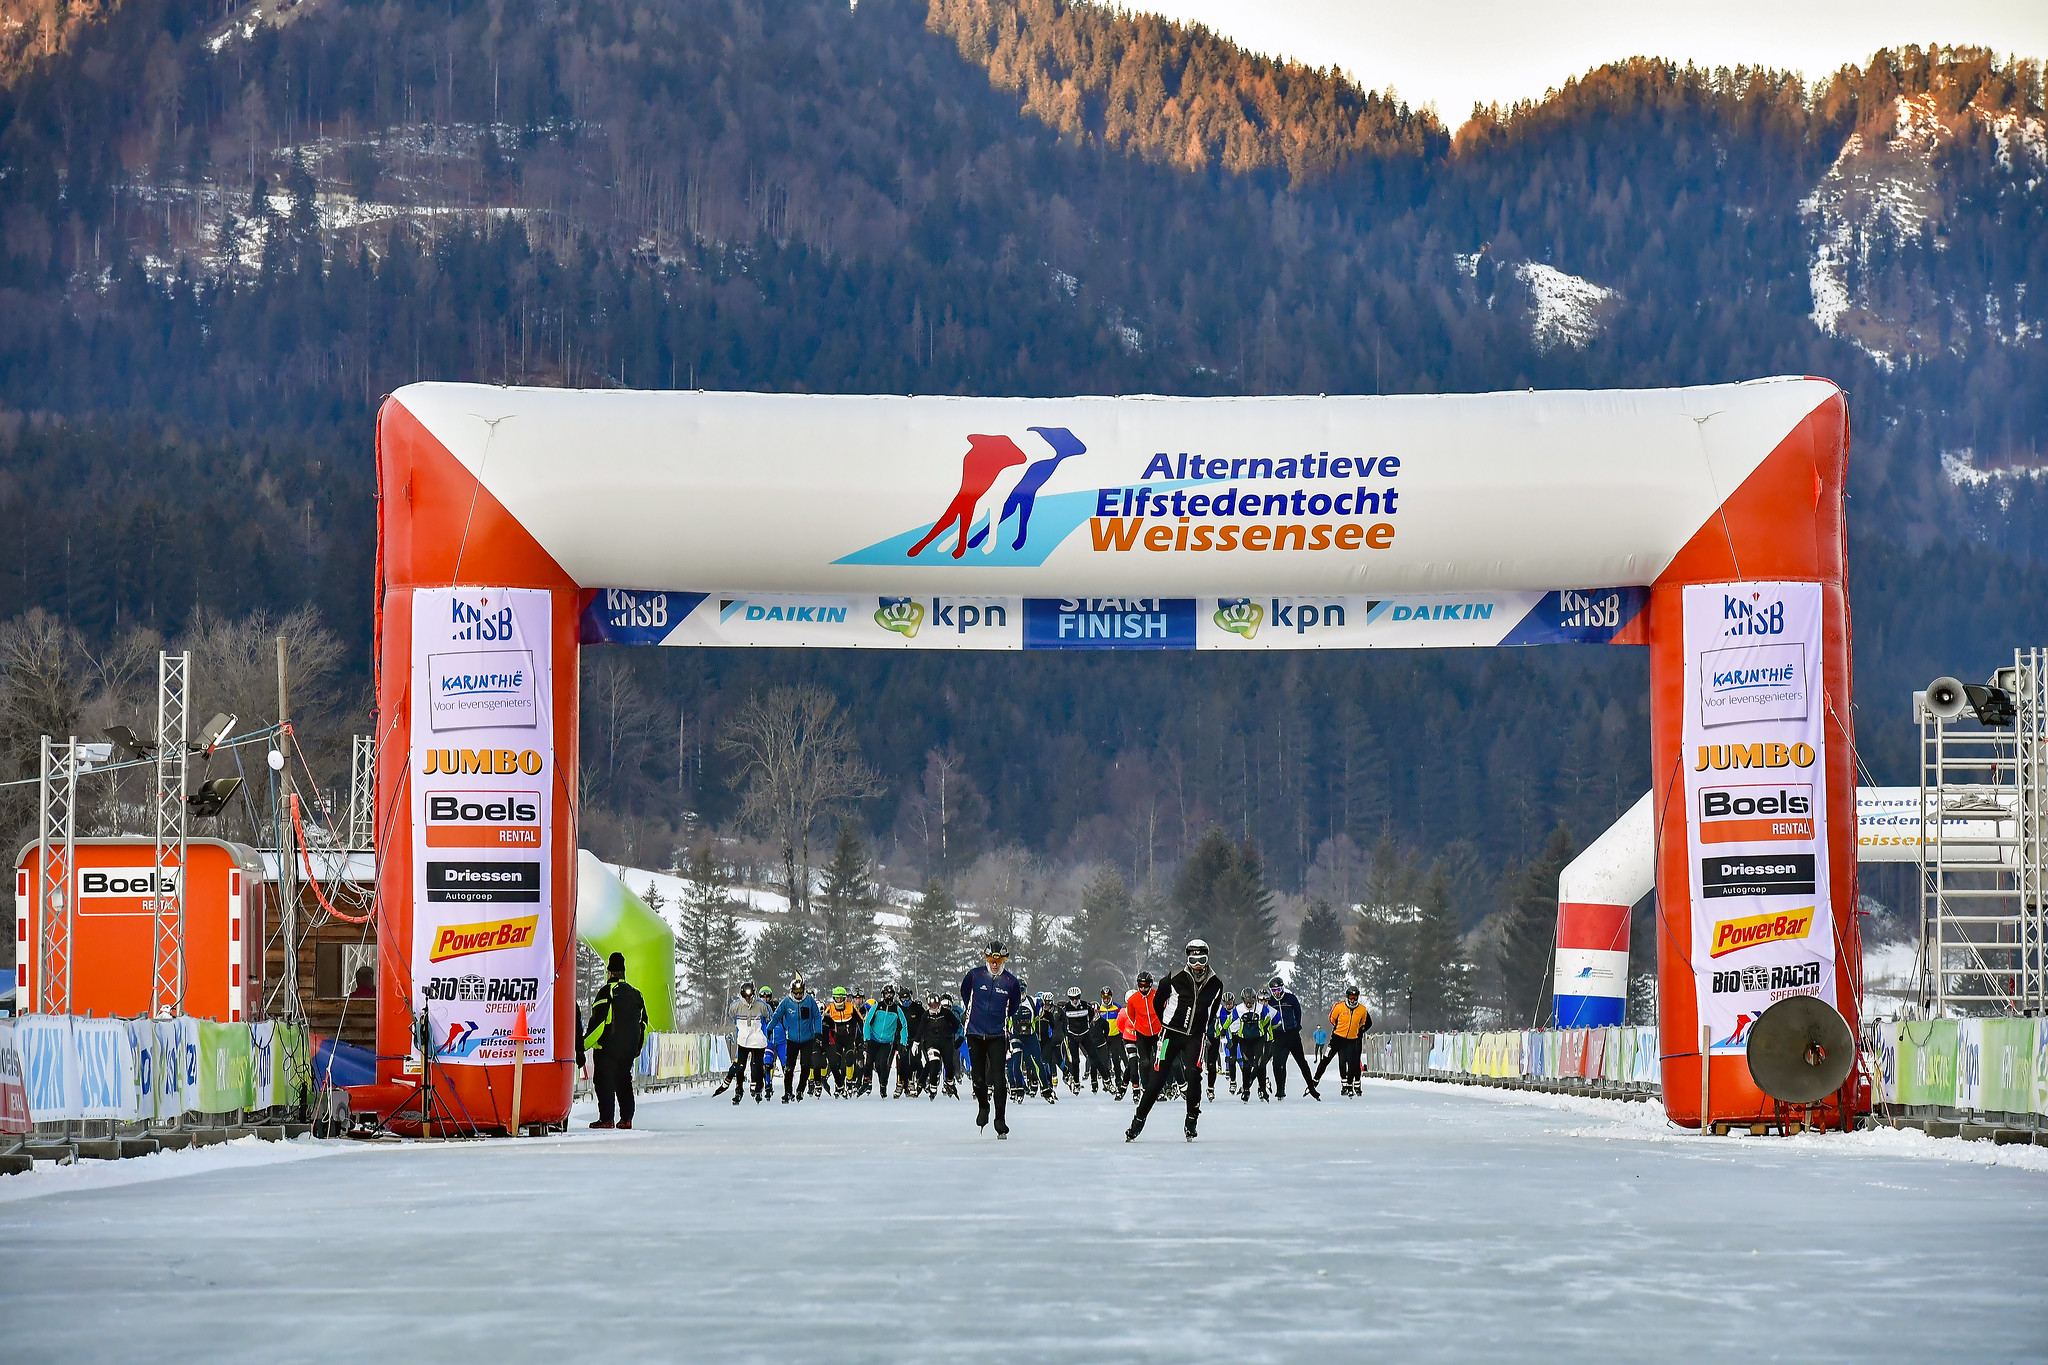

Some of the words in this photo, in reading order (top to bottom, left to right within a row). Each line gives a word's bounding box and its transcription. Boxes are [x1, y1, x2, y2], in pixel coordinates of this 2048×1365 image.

[1141, 451, 1401, 480] Alternatieve
[1096, 486, 1399, 517] Elfstedentocht
[1090, 517, 1395, 551] Weissensee
[452, 597, 513, 640] KNSB
[607, 588, 668, 627] KNSB
[745, 605, 848, 623] DAIKIN
[932, 598, 1006, 634] kpn
[1271, 599, 1345, 634] kpn
[1392, 603, 1494, 621] DAIKIN
[1560, 590, 1619, 627] KNSB
[1724, 594, 1784, 636] KNSB
[1058, 613, 1167, 638] FINISH
[442, 671, 523, 691] KARINTHIË
[1713, 664, 1794, 687] KARINTHIË
[433, 701, 455, 711] Voor
[458, 698, 532, 711] levensgenieters
[1705, 697, 1726, 707] Voor
[1728, 691, 1803, 705] levensgenieters
[422, 749, 543, 775] JUMBO
[1694, 742, 1816, 772] JUMBO
[430, 797, 536, 821] Boels
[1704, 790, 1809, 817] Boels
[499, 830, 536, 842] RENTAL
[1772, 823, 1810, 835] RENTAL
[445, 869, 522, 882] Driessen
[1720, 863, 1797, 876] Driessen
[83, 873, 175, 893] Boels
[1722, 886, 1767, 895] Autogroep
[445, 892, 493, 902] Autogroep
[438, 924, 532, 952] PowerBar
[1717, 916, 1808, 947] PowerBar
[1771, 962, 1820, 989] RACER
[487, 978, 539, 1001] RACER
[485, 1002, 536, 1013] SPEEDWAR
[0, 1038, 19, 1078] oels
